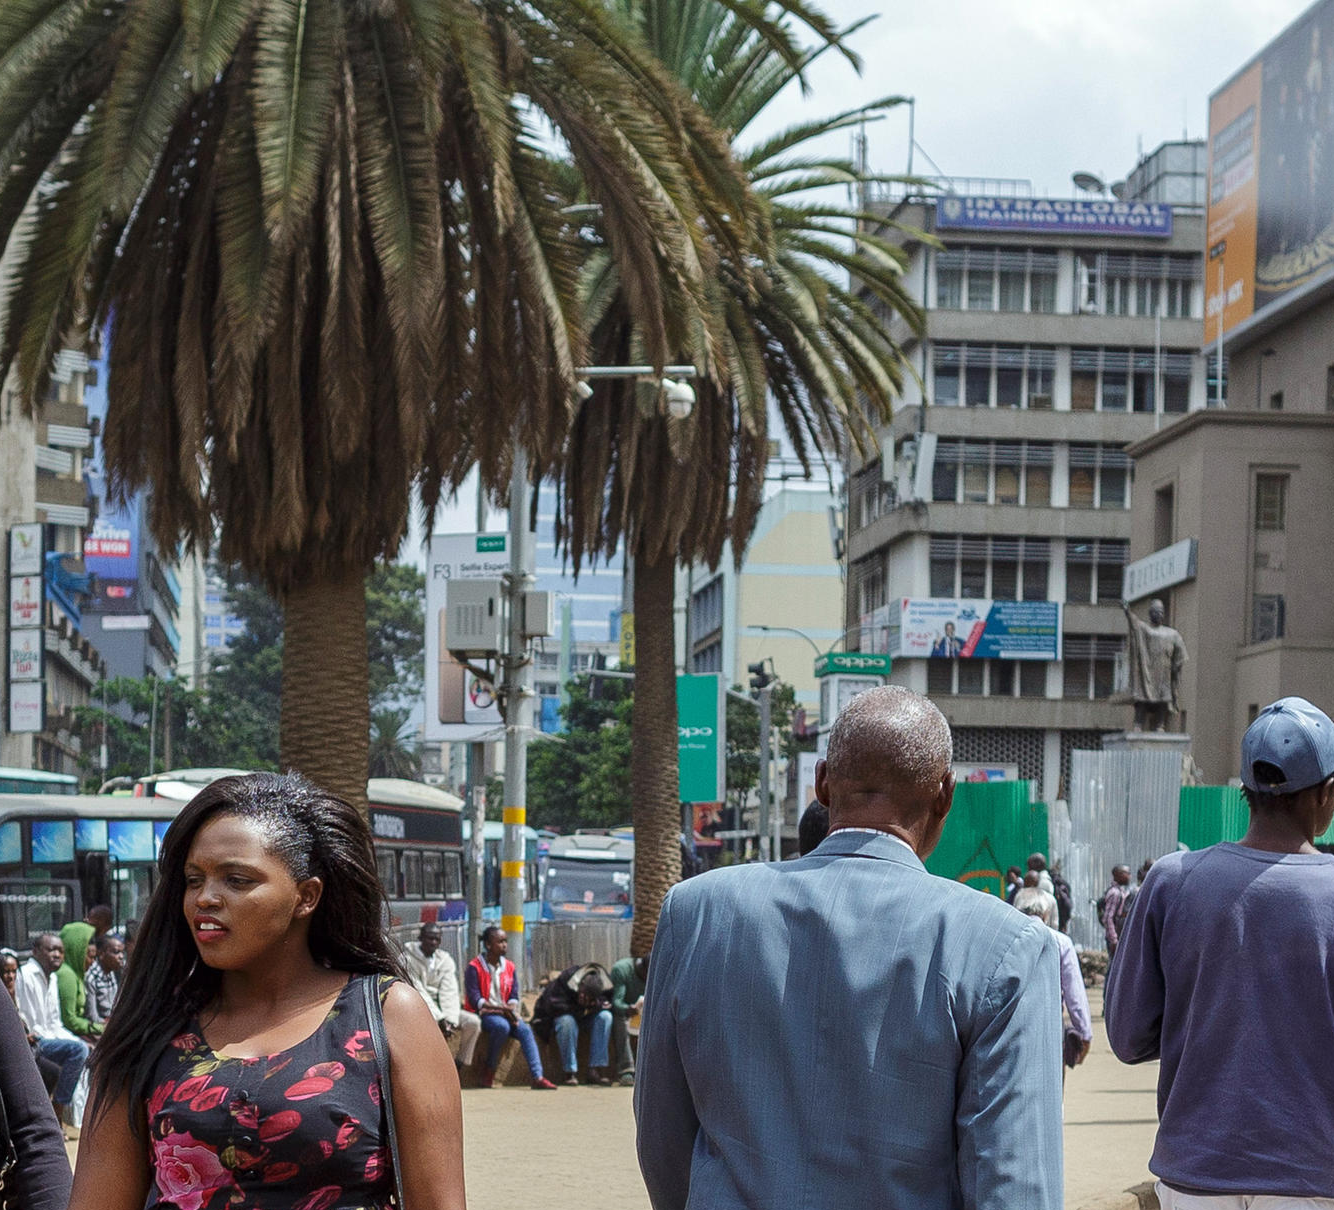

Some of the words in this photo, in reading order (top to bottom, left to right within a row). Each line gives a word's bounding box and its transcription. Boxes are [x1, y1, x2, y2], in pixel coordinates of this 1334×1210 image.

[966, 197, 1161, 216] INTRAGLOBAL
[966, 209, 1059, 222] TRAINING
[1065, 213, 1165, 226] INSTITUTE
[433, 563, 451, 580] F3
[833, 656, 886, 668] oppo
